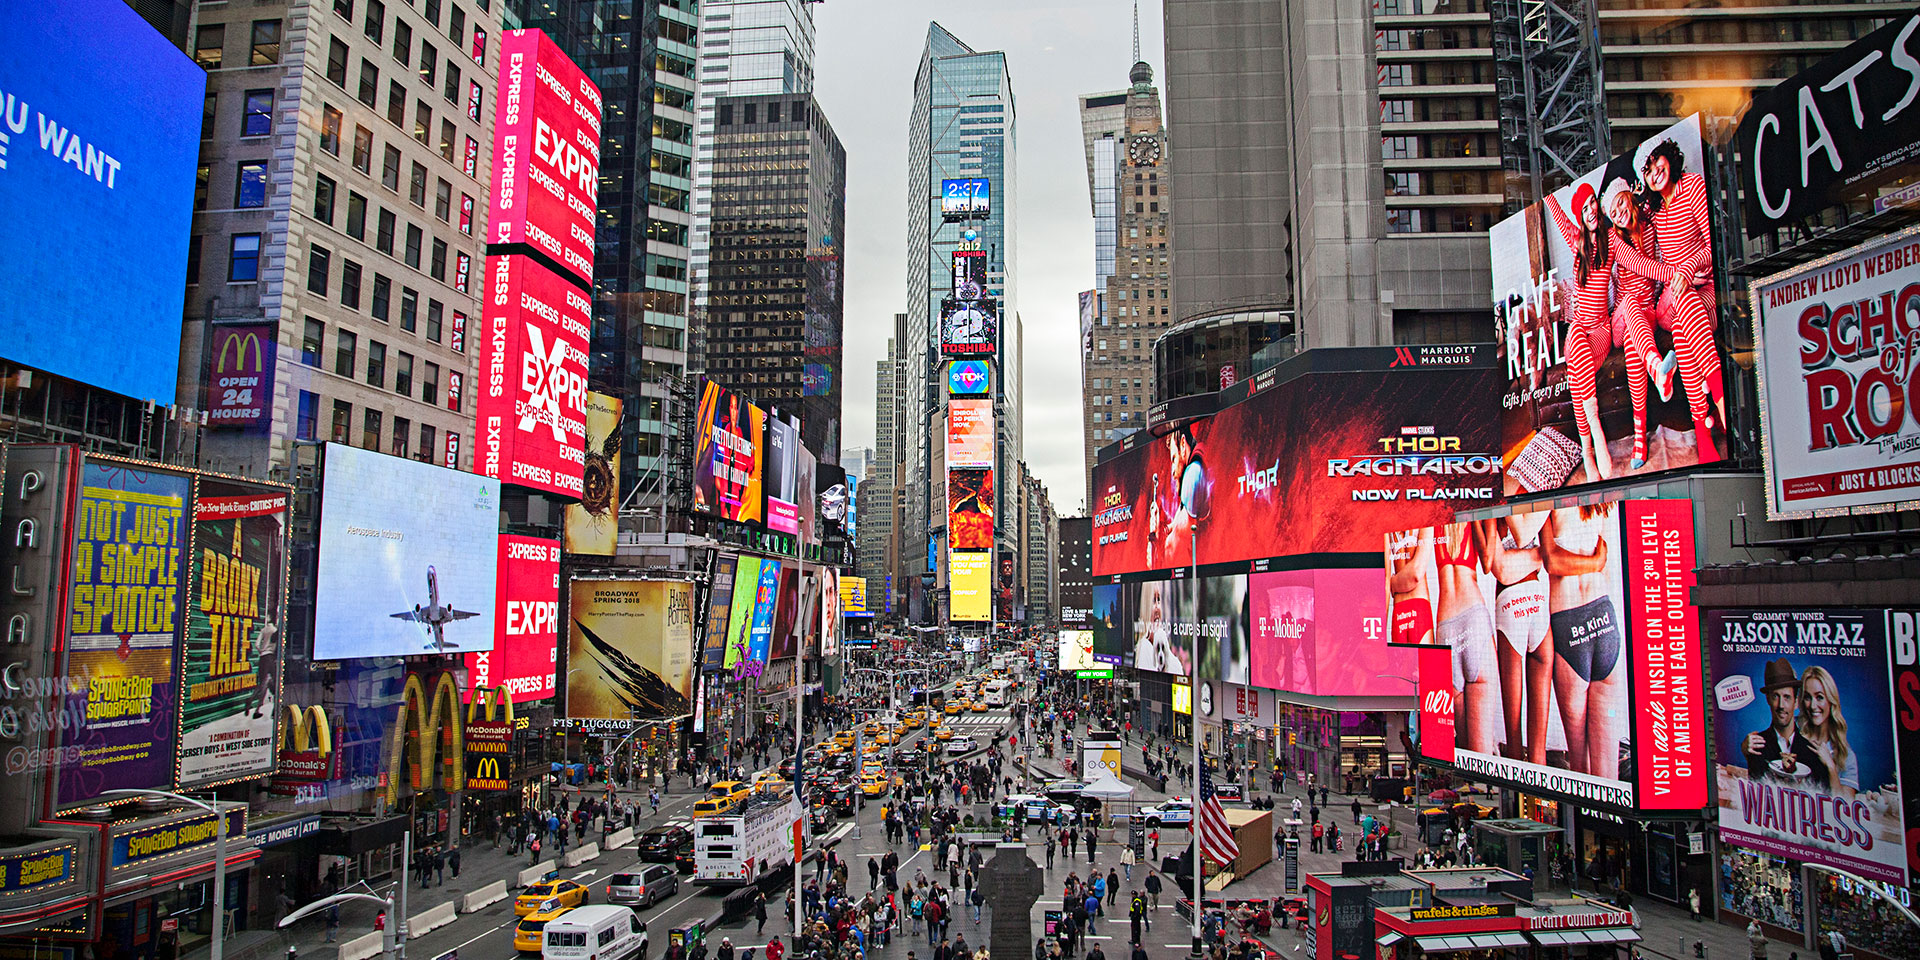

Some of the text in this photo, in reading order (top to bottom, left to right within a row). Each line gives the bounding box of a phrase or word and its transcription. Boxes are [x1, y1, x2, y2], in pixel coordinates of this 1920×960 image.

[506, 53, 523, 125] EXPRESS
[536, 62, 571, 105] EXPRESS
[1754, 14, 1920, 219] CATS
[37, 111, 121, 189] WANT
[500, 135, 517, 210] EXPRESS
[1861, 156, 1905, 178] Simon Theatre
[529, 163, 565, 201] EXPRESS
[948, 182, 983, 197] 2:37
[525, 220, 562, 256] EXPRESS
[1821, 262, 1860, 293] LLOYD
[521, 292, 559, 325] EXPRESS
[1505, 267, 1561, 331] GIVE
[1798, 282, 1920, 370] SCHO
[490, 317, 506, 397] EXPRESS
[942, 343, 995, 353] TOSHIBA
[1421, 347, 1477, 355] MARRIOTT
[1507, 321, 1569, 381] REAL
[1421, 356, 1471, 364] MARQUIS
[219, 377, 259, 387] OPEN
[961, 372, 985, 382] TDK
[1257, 367, 1277, 384] MARRIOTT
[1257, 378, 1275, 391] MARQUIS
[222, 389, 253, 406] 24
[1502, 390, 1519, 410] Gifts
[1520, 387, 1533, 403] for
[1533, 381, 1554, 402] every
[212, 408, 260, 419] HOURS
[1378, 437, 1461, 452] THOR
[1882, 437, 1896, 447] THE
[512, 461, 551, 485] EXPRESS
[1328, 456, 1503, 477] RAGNAROK
[1839, 473, 1865, 491] JUST
[1868, 474, 1875, 488] 4
[1104, 492, 1122, 507] THOR
[1352, 487, 1493, 501] NOW PLAYING
[207, 502, 219, 512] New
[220, 501, 233, 514] York
[233, 500, 249, 511] Times
[273, 497, 286, 508] PICK
[79, 499, 182, 546] NOT JUST
[1095, 505, 1133, 528] RAGNAROK
[232, 517, 242, 558] A
[347, 525, 404, 542] Aerospace Industry
[1100, 531, 1128, 545] NOW PLAYING
[508, 542, 547, 561] EXPRESS
[76, 542, 179, 585] A SIMPLE
[201, 548, 261, 618] BRONX
[669, 588, 690, 608] HARRY
[757, 585, 776, 604] COCO
[1501, 597, 1527, 612] I've been
[72, 584, 177, 633] SPONGE
[667, 606, 691, 627] POTTER
[709, 604, 729, 619] COME
[1514, 605, 1541, 619] this year
[1792, 613, 1824, 621] WINNER
[1179, 619, 1228, 642] cure in sight
[1571, 611, 1610, 638] Be Kind
[1722, 623, 1865, 646] JASON MRAZ
[208, 614, 253, 676] TALE
[706, 633, 725, 649] AWAY
[1723, 644, 1866, 657] ON BROADWAY FOR 10 WEEKS ONLY!
[1641, 512, 1671, 796] VISIT aerie INSIDE ON THE 3RD LEVEL
[1663, 529, 1692, 777] OF AMERICAN EAGLE OUTFITTERS
[733, 642, 764, 690] Disney
[88, 675, 153, 702] SPONGEBOB
[1722, 690, 1748, 702] BAREILLES
[1727, 686, 1740, 694] SARA
[86, 698, 152, 720] SQUAREPANTS
[466, 726, 512, 734] McDonald's
[553, 718, 573, 728] FTS
[214, 731, 243, 742] COMBINATION
[180, 747, 204, 758] JERSEY
[204, 743, 220, 754] BOYS
[226, 741, 241, 751] WEST
[242, 739, 253, 749] SIDE
[280, 760, 326, 770] cDonald's
[1455, 755, 1632, 807] AMERICAN EAGLE OUTFITTERS
[1738, 779, 1873, 851] WAITRESS
[129, 817, 230, 857] SPONGEBOB SQUAREPAS
[268, 820, 320, 842] MONEY ATM
[20, 854, 64, 875] SPONGEBOB
[1725, 831, 1901, 880] BROOKS ATKINSON THEATRE WAITRESSTHEMUSICAL.COM
[19, 866, 64, 886] SQUAREPANTS
[1530, 911, 1628, 929] MIGHTY QUINN'S BBQ
